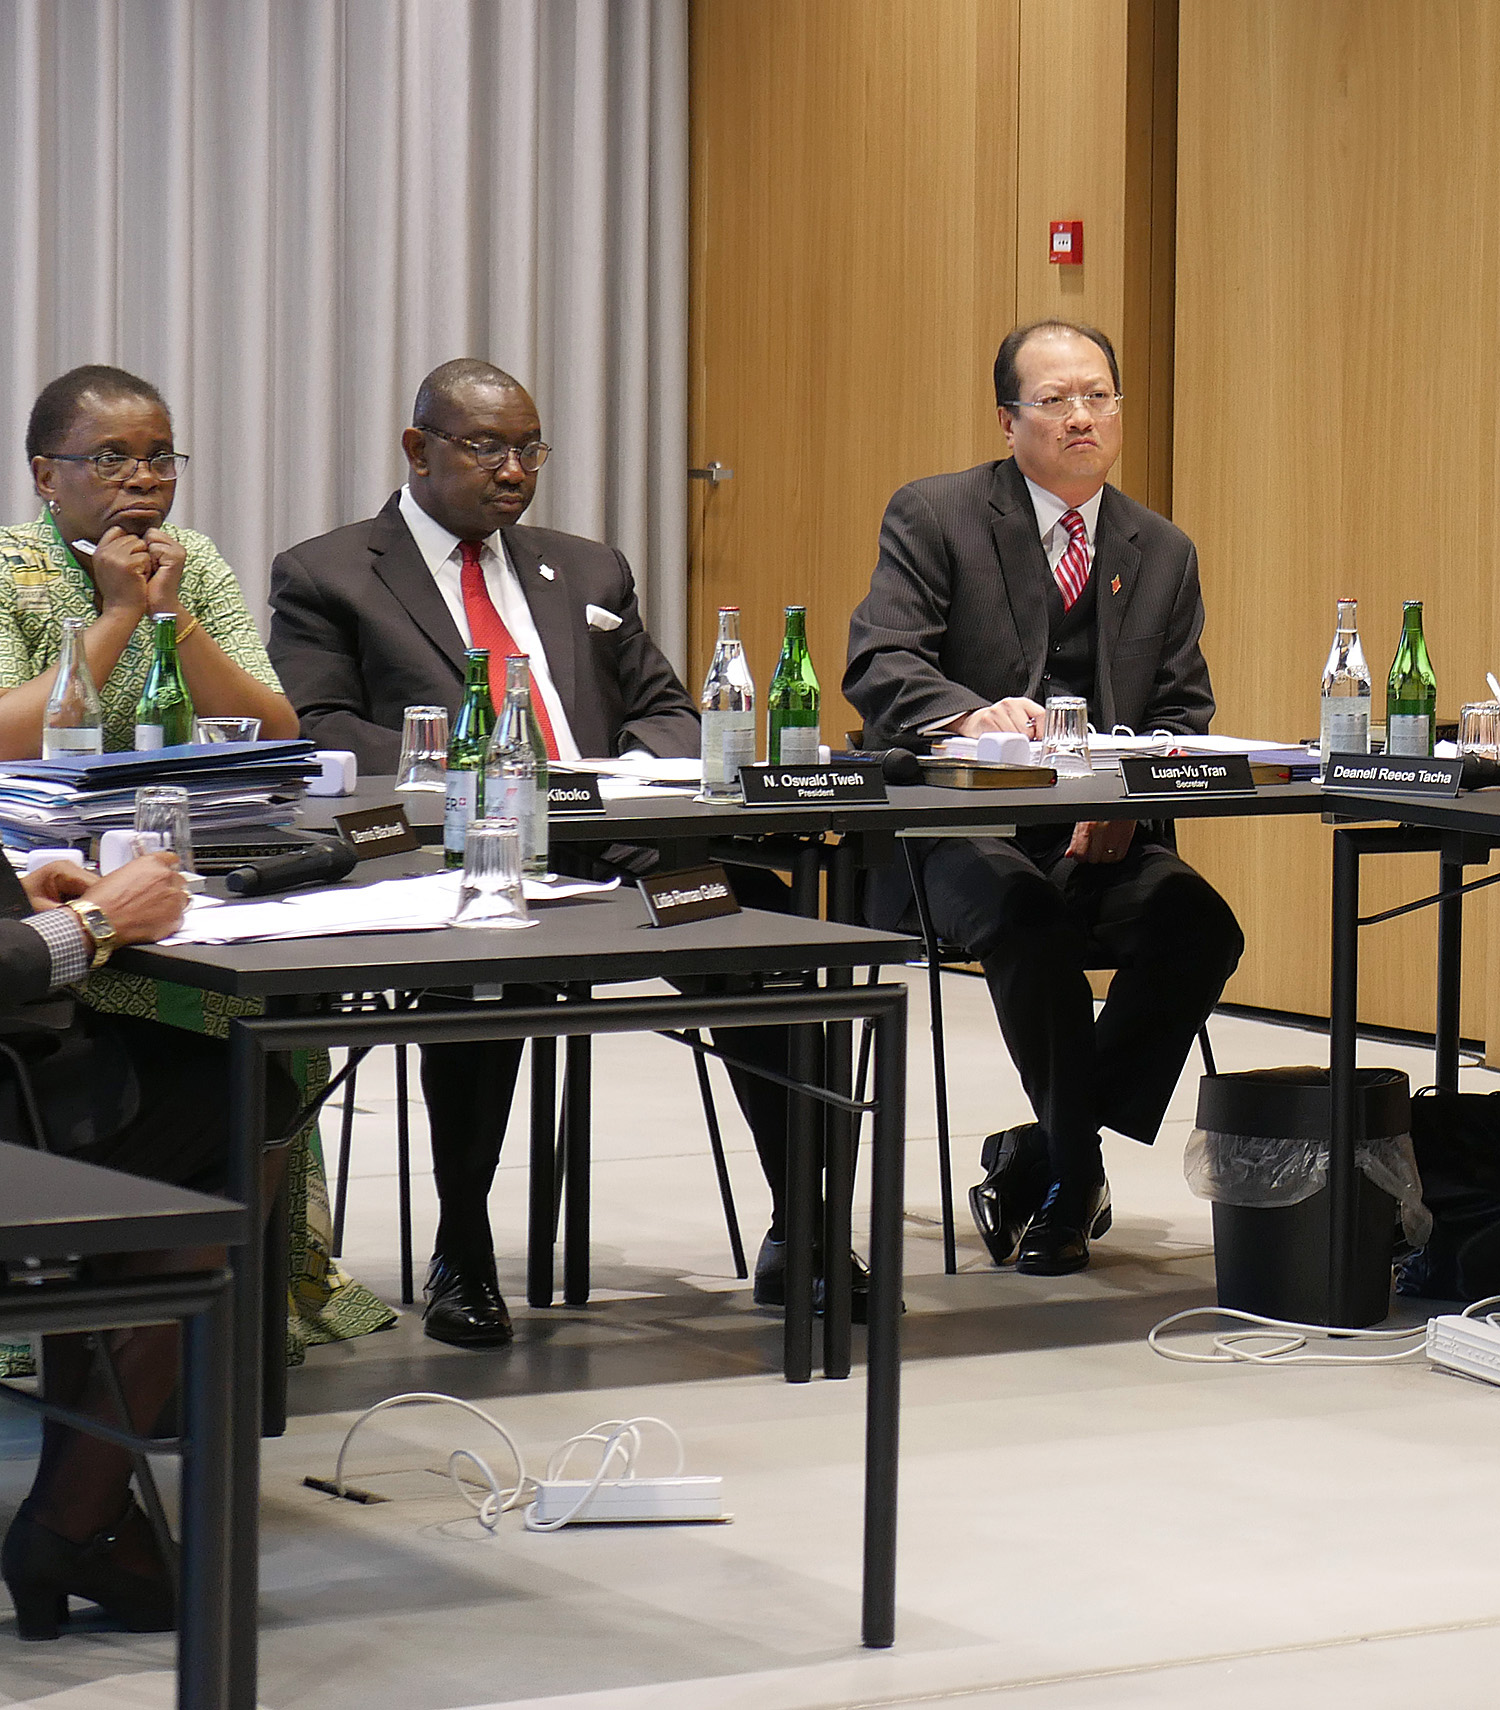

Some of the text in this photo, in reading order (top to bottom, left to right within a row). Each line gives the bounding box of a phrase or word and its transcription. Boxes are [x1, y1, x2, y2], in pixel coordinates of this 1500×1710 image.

[1151, 765, 1227, 779] Luan-Vu Tran
[1333, 765, 1452, 784] Deanell Reece Tacha
[763, 773, 864, 787] N. Oswald Tweh
[1175, 780, 1209, 789] Secretary
[547, 788, 590, 801] Kiboko
[797, 789, 835, 797] President
